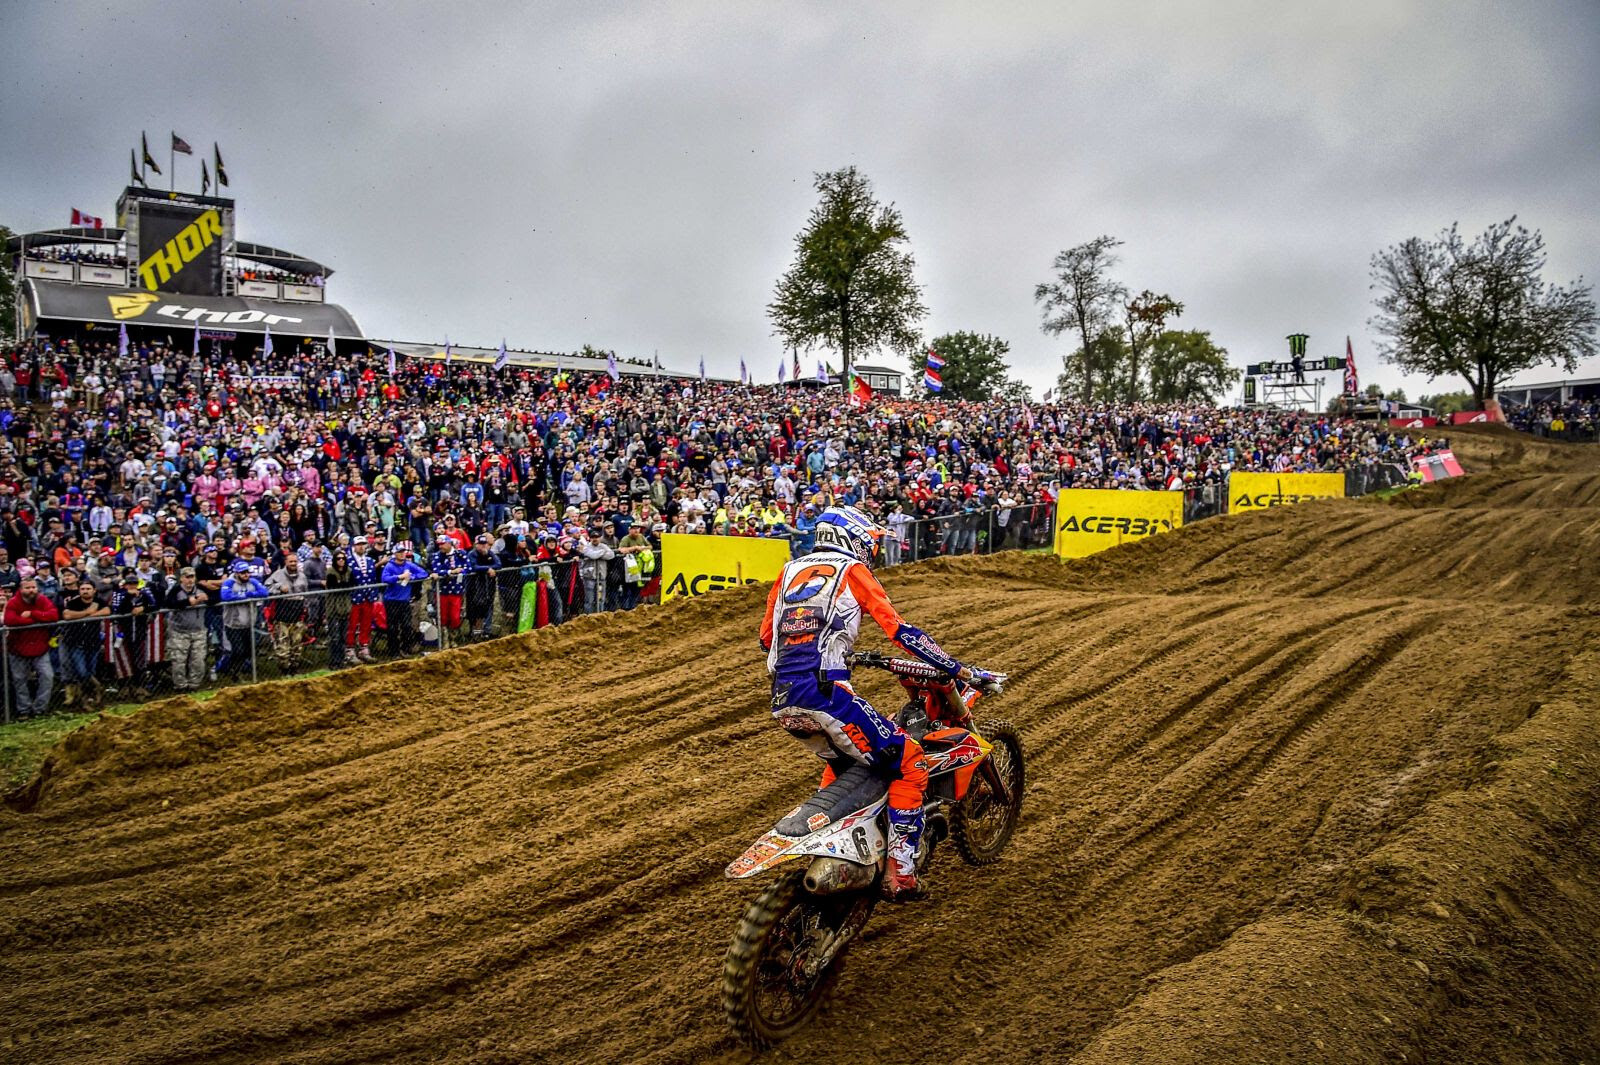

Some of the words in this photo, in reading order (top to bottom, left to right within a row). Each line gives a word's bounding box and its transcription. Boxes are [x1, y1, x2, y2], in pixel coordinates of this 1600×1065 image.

[138, 208, 224, 292] THOR
[156, 304, 303, 324] thor
[1271, 361, 1326, 373] FINSH
[784, 563, 836, 604] 6
[891, 664, 938, 678] RENTHAL
[851, 825, 872, 862] 6
